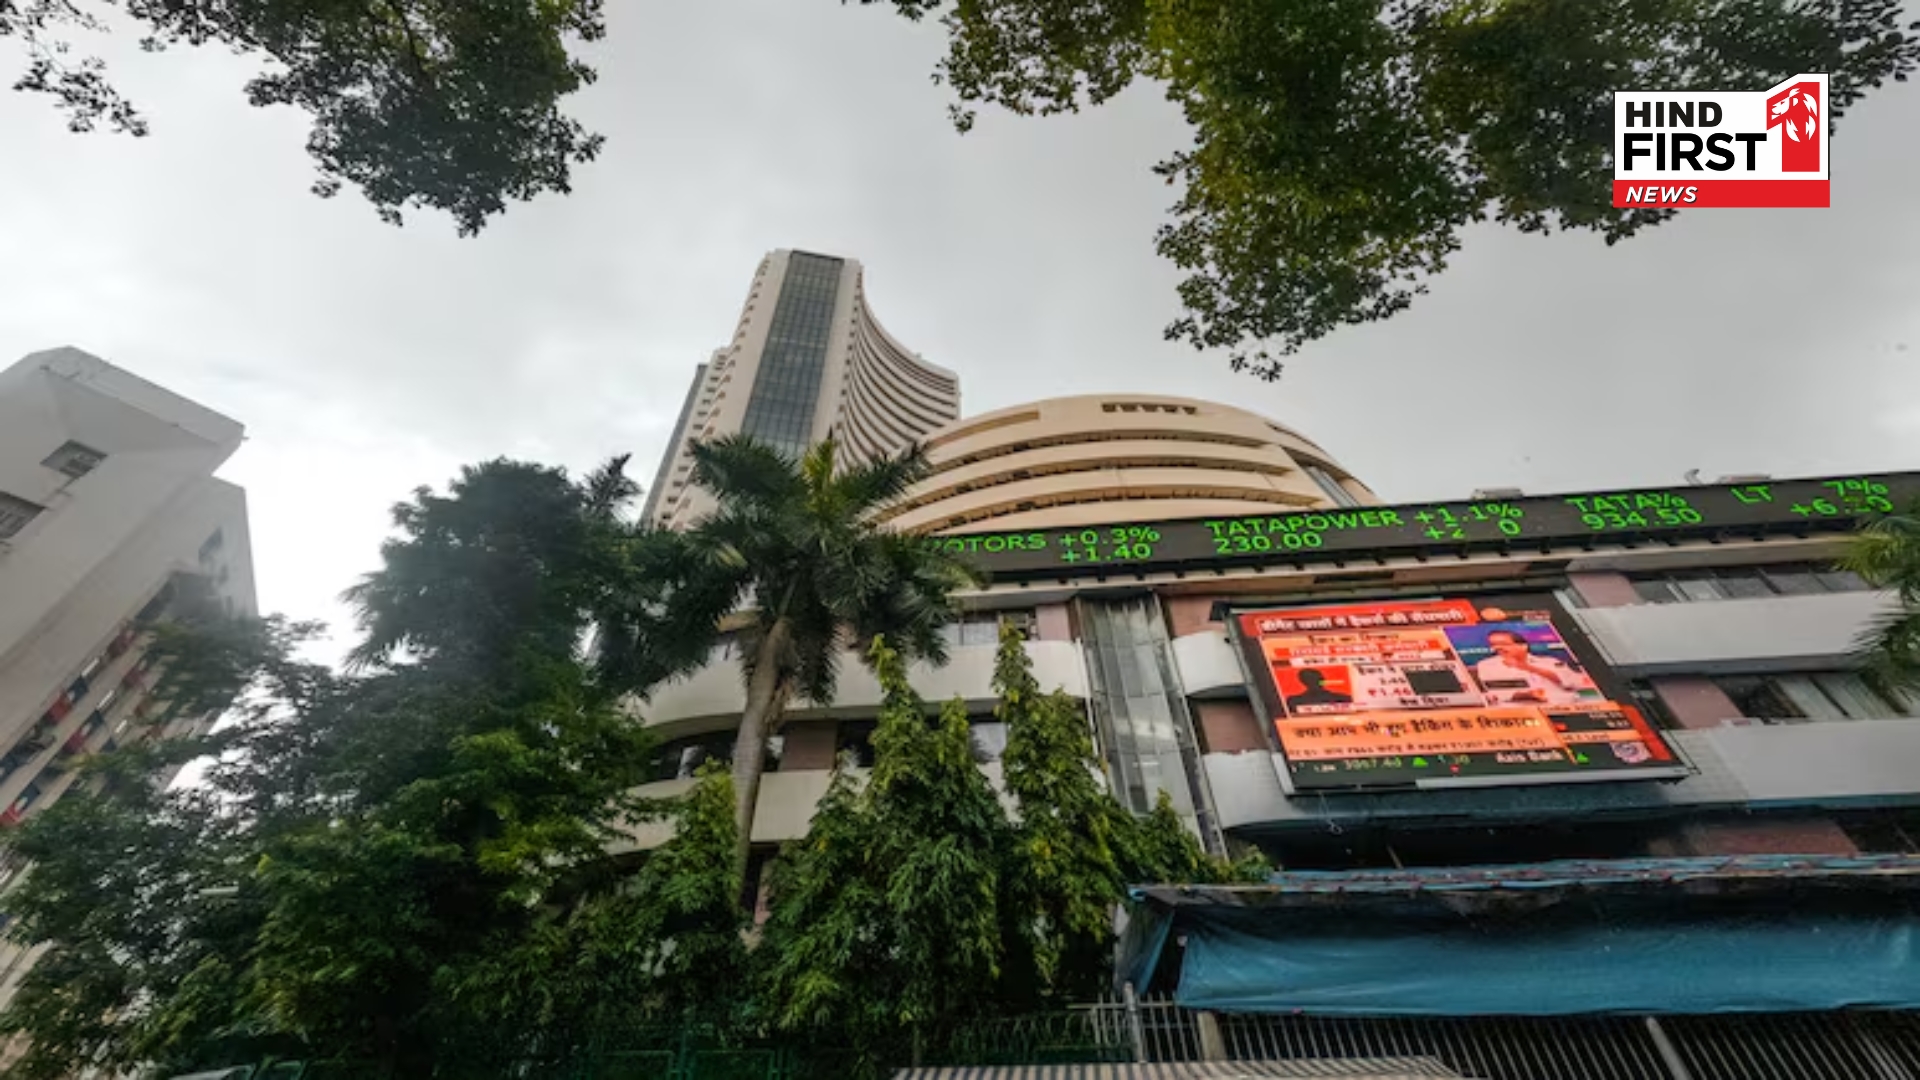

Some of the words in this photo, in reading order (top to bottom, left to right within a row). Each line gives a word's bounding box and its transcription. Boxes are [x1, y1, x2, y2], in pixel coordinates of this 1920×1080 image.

[1730, 485, 1774, 504] LT
[1204, 510, 1404, 538] TATAPOWER
[1413, 503, 1524, 523] +1.1%
[1582, 508, 1704, 530] 934.50
[928, 533, 1047, 552] OTORS
[1058, 527, 1160, 546] +0.3%
[1214, 532, 1323, 554] 230.00
[1061, 543, 1153, 563] +1.40
